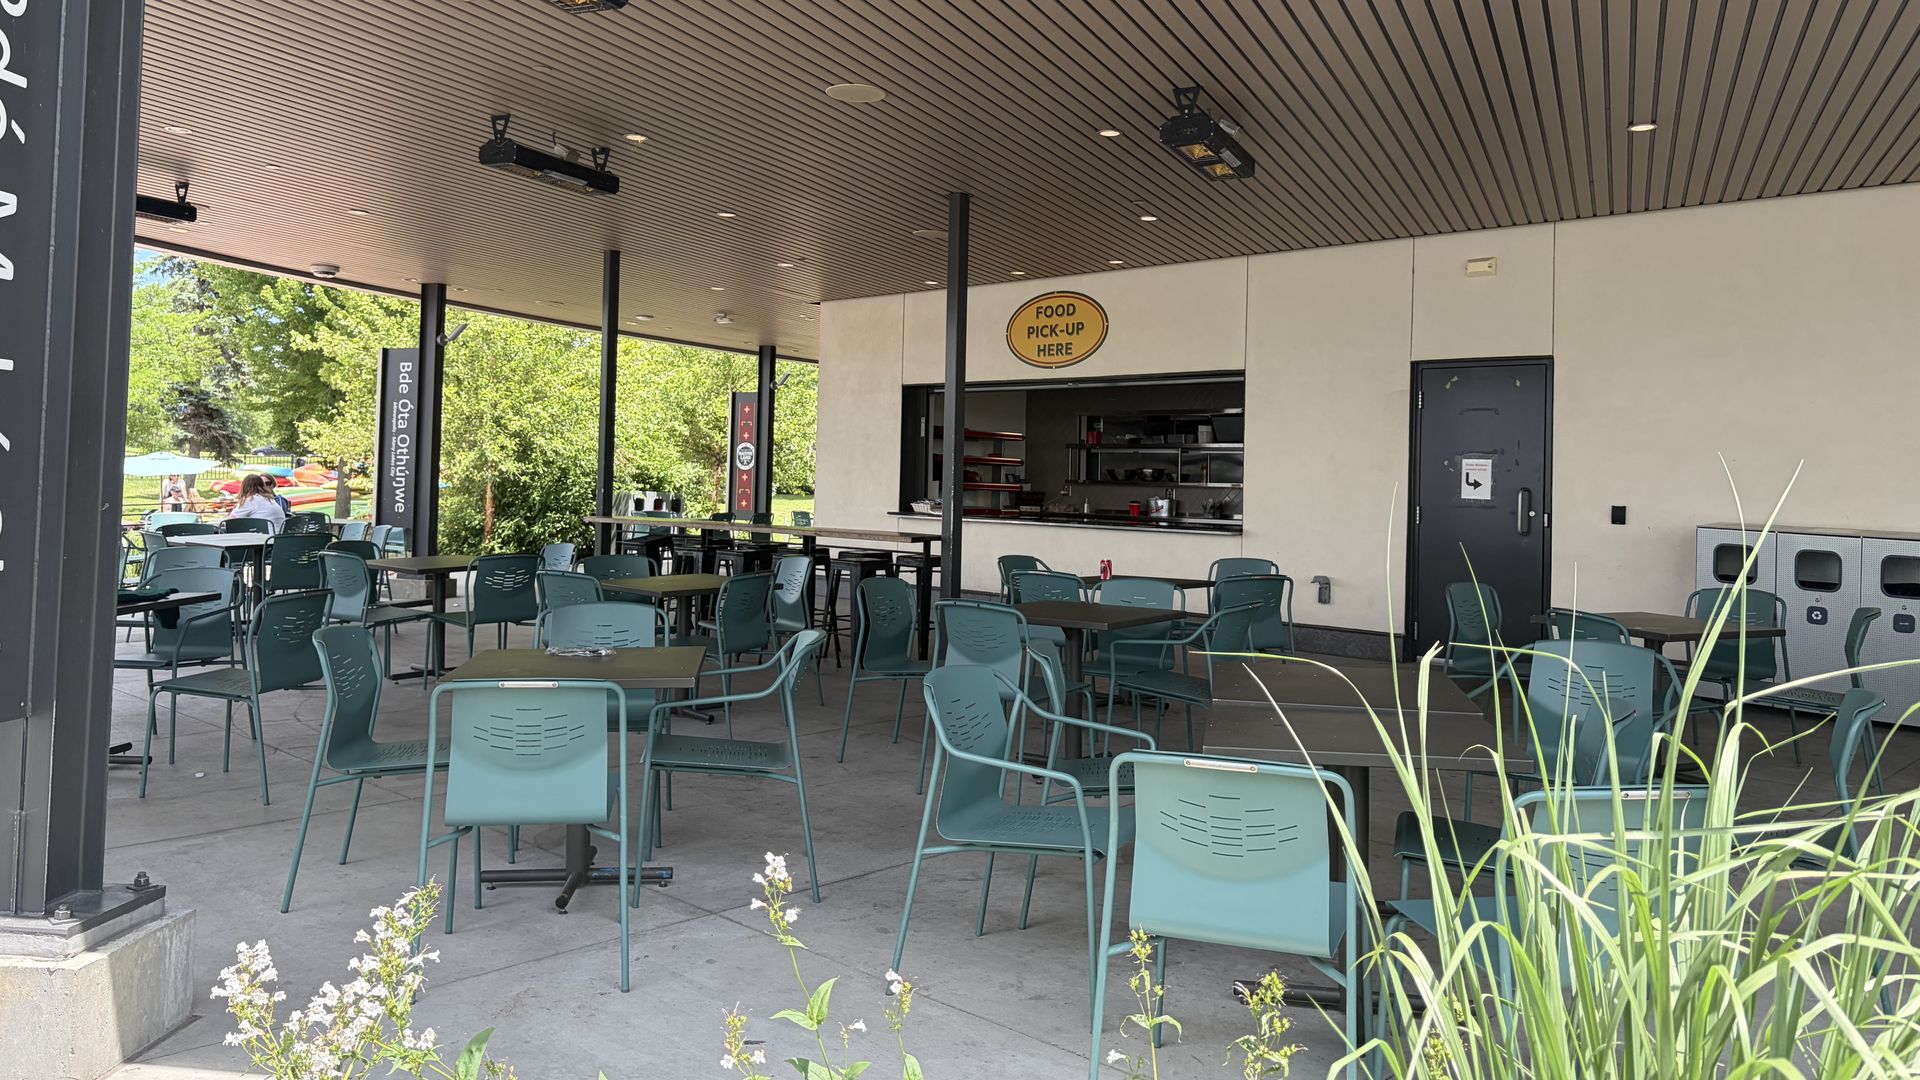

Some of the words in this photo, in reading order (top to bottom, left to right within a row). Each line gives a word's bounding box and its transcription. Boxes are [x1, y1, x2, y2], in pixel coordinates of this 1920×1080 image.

[1036, 303, 1076, 319] FOOD
[1027, 322, 1084, 339] PICK-UP
[1037, 342, 1073, 357] HERE
[399, 362, 413, 394] Bde
[398, 399, 414, 428] Óta
